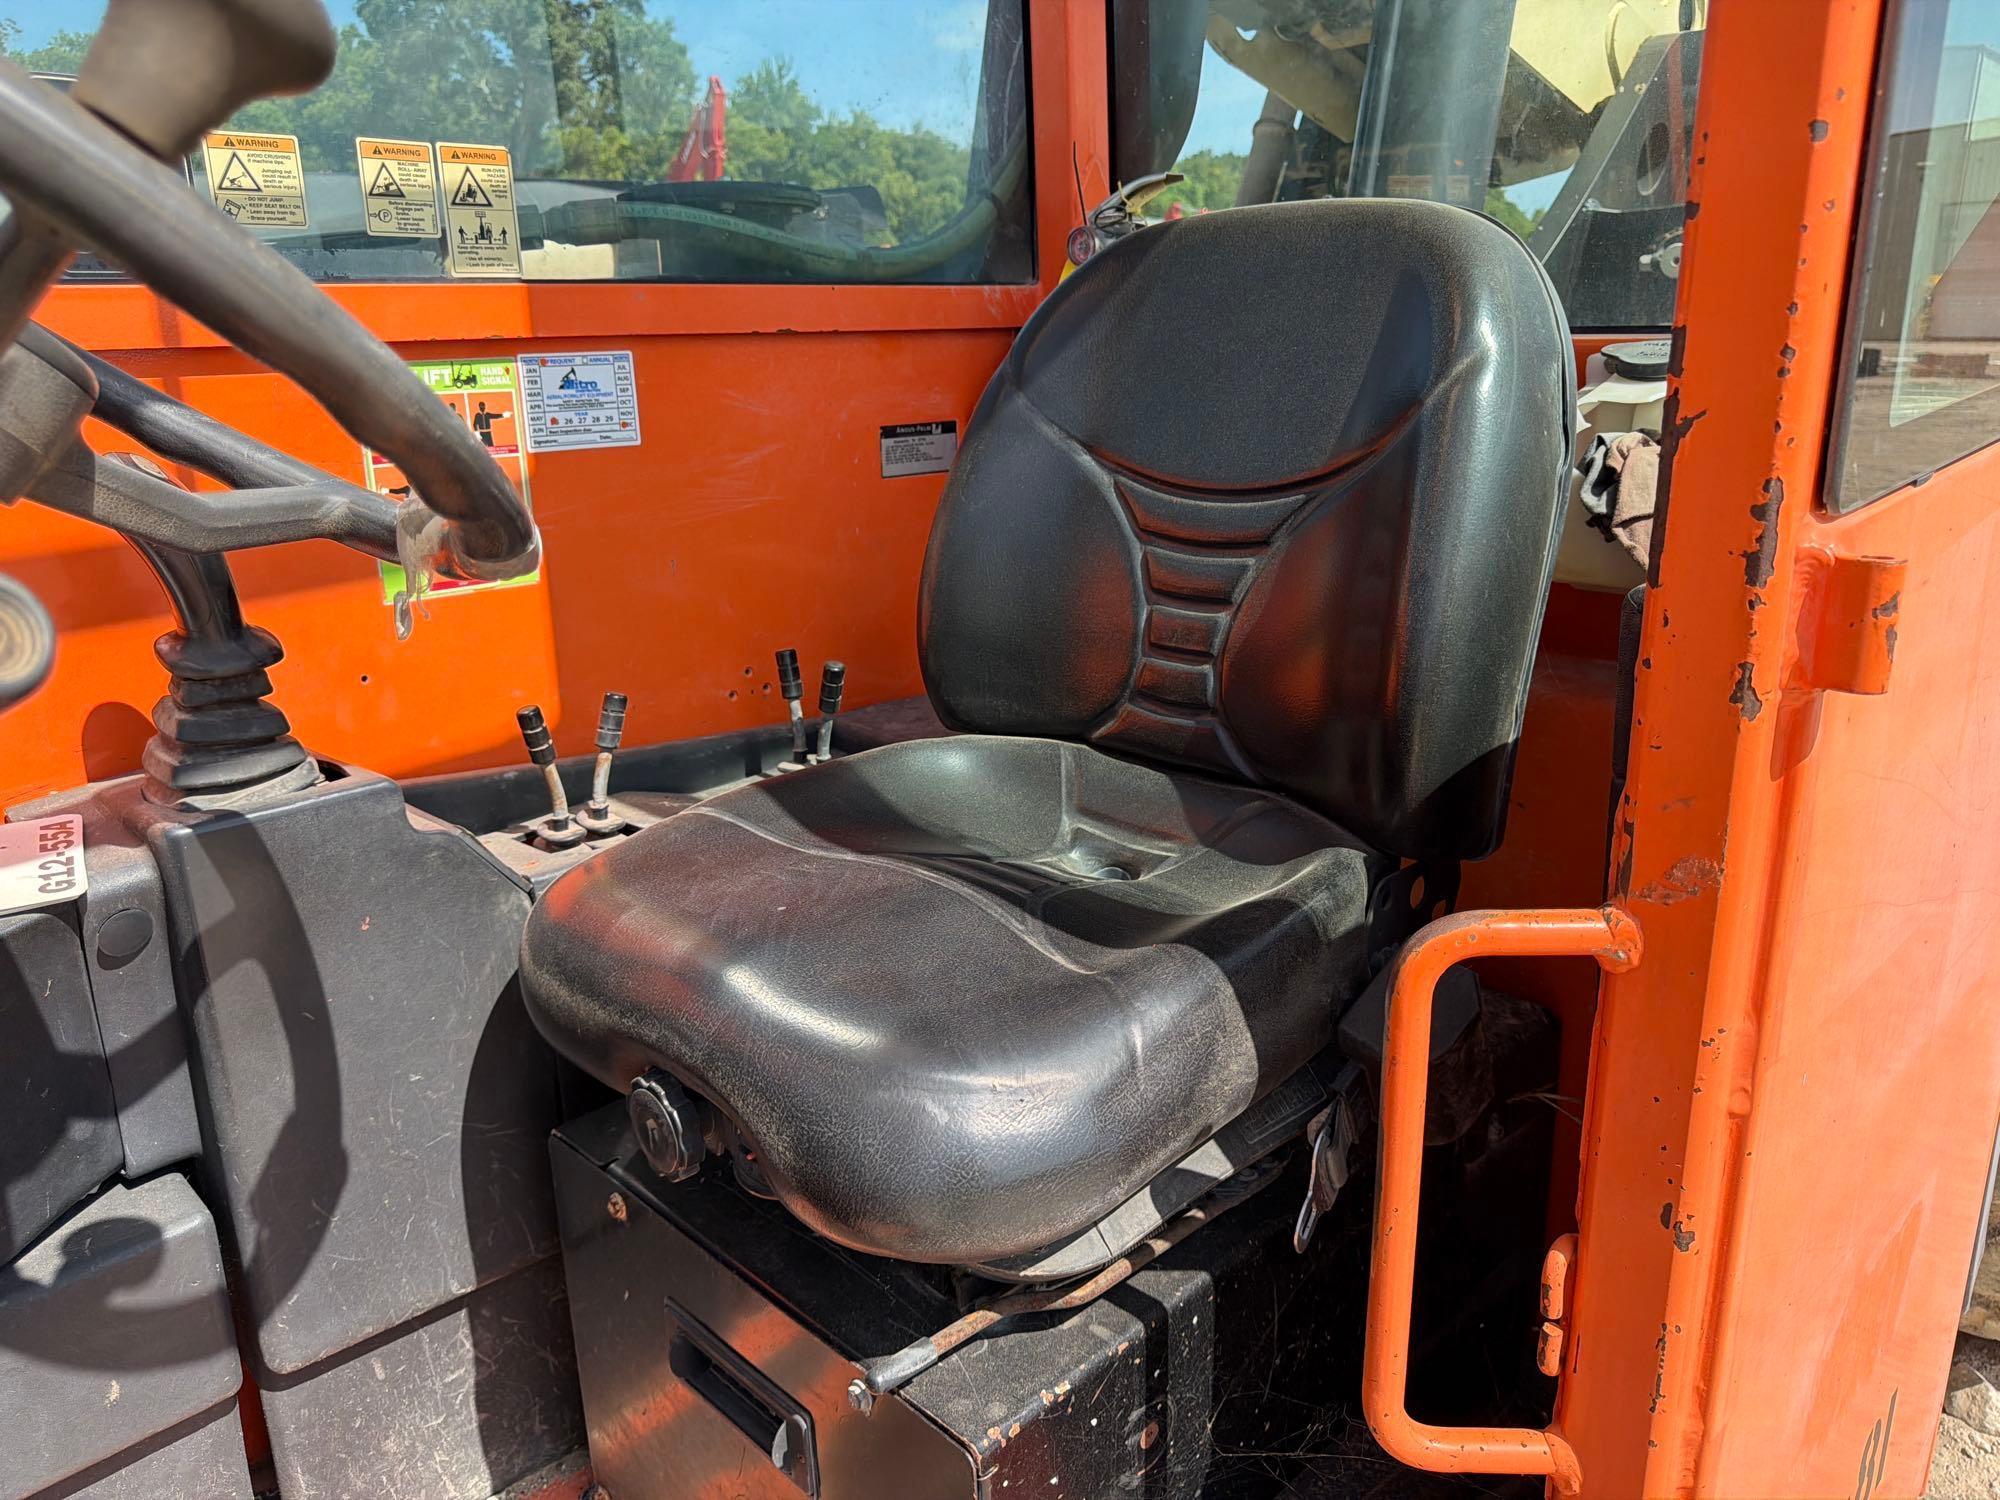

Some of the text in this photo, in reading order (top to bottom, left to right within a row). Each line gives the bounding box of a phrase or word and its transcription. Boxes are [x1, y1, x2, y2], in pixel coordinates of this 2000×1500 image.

[236, 138, 279, 148] WARNING
[383, 148, 421, 157] WARNING
[460, 152, 497, 161] WARNING
[480, 366, 503, 376] HAND
[481, 375, 512, 386] SIGNAL
[38, 820, 76, 894] G12-55A
